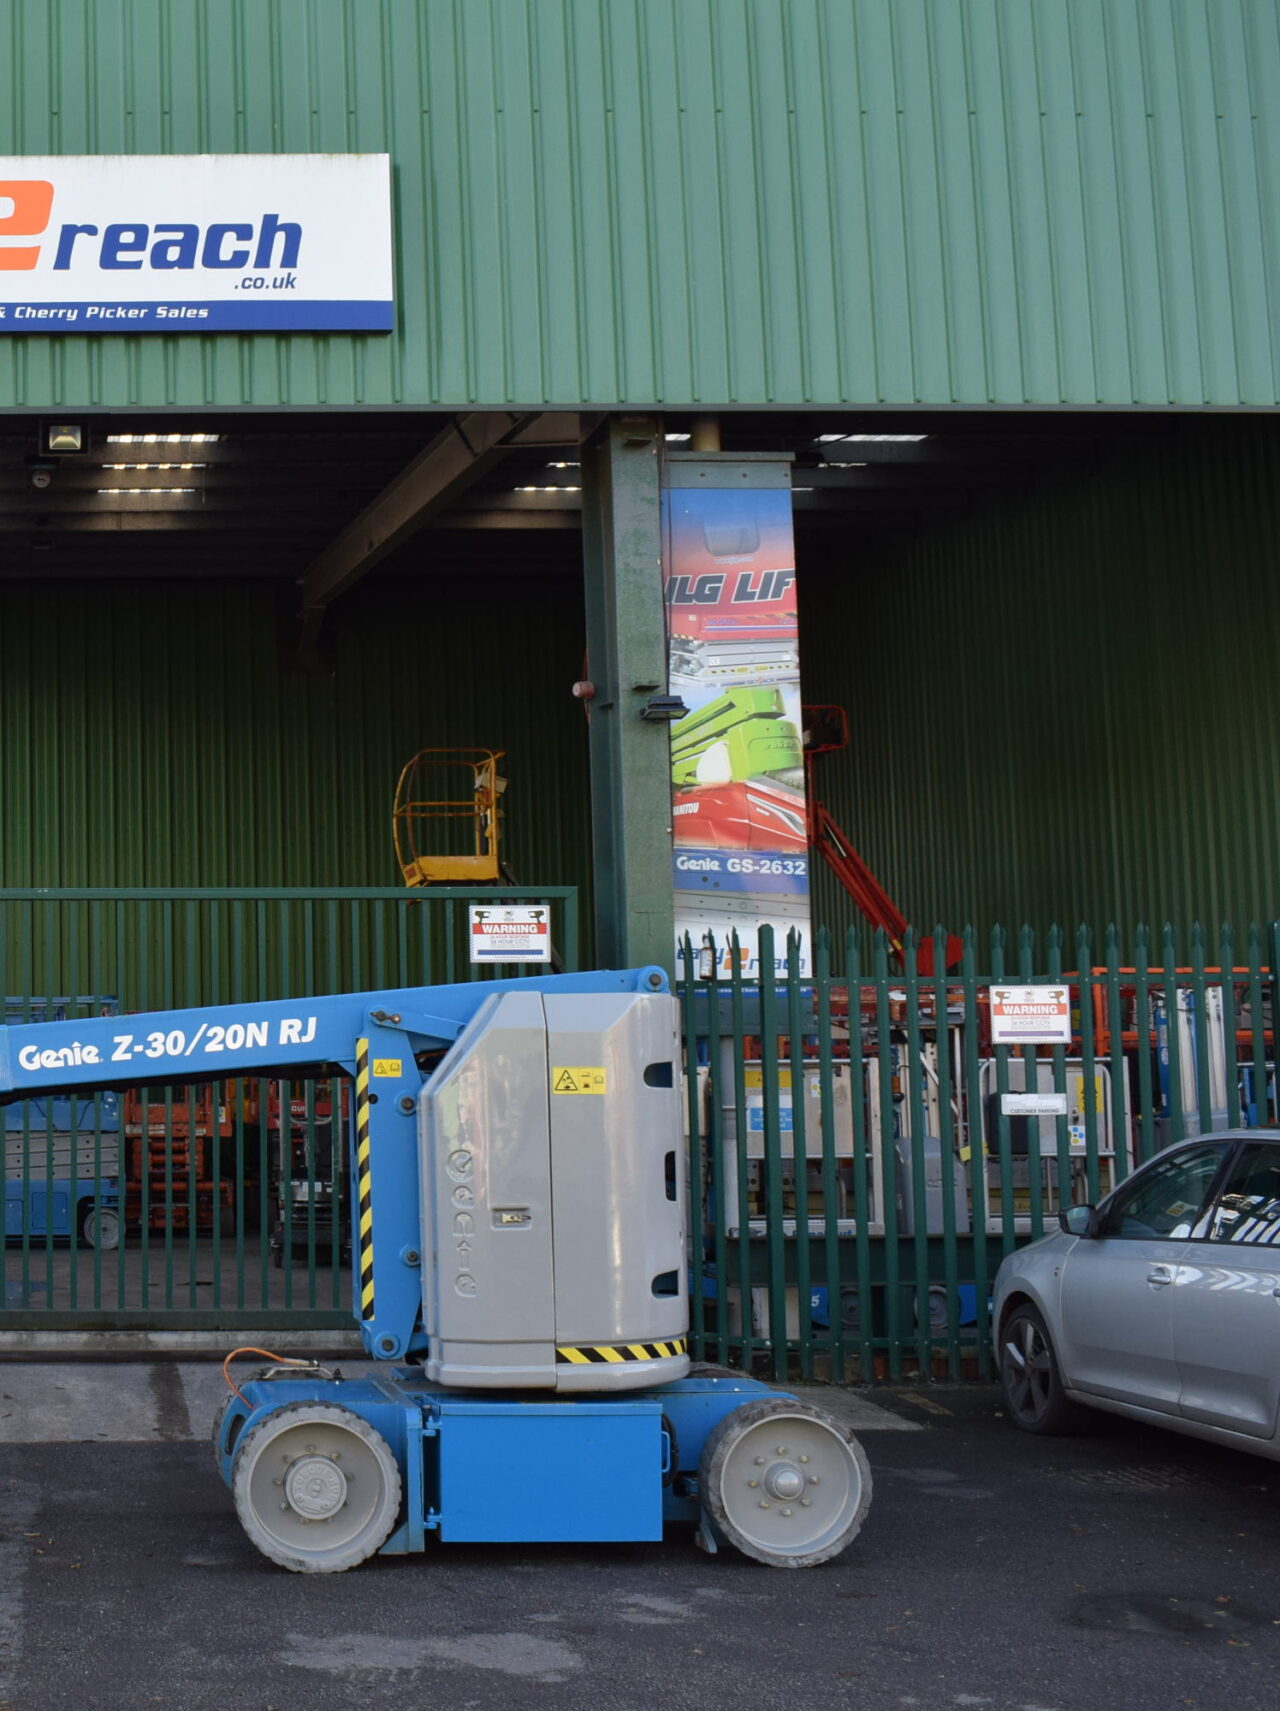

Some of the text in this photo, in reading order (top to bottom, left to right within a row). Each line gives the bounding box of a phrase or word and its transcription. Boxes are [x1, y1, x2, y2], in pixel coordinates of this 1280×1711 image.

[234, 272, 297, 290] .co.uk
[14, 306, 78, 320] Cherry
[85, 306, 149, 318] Picker
[155, 306, 209, 318] Sales
[676, 856, 806, 875] Genie GS-2632
[482, 924, 538, 933] WARNING
[1002, 1005, 1058, 1014] WARNING
[18, 1016, 318, 1071] Genie Z-30/20N RJ
